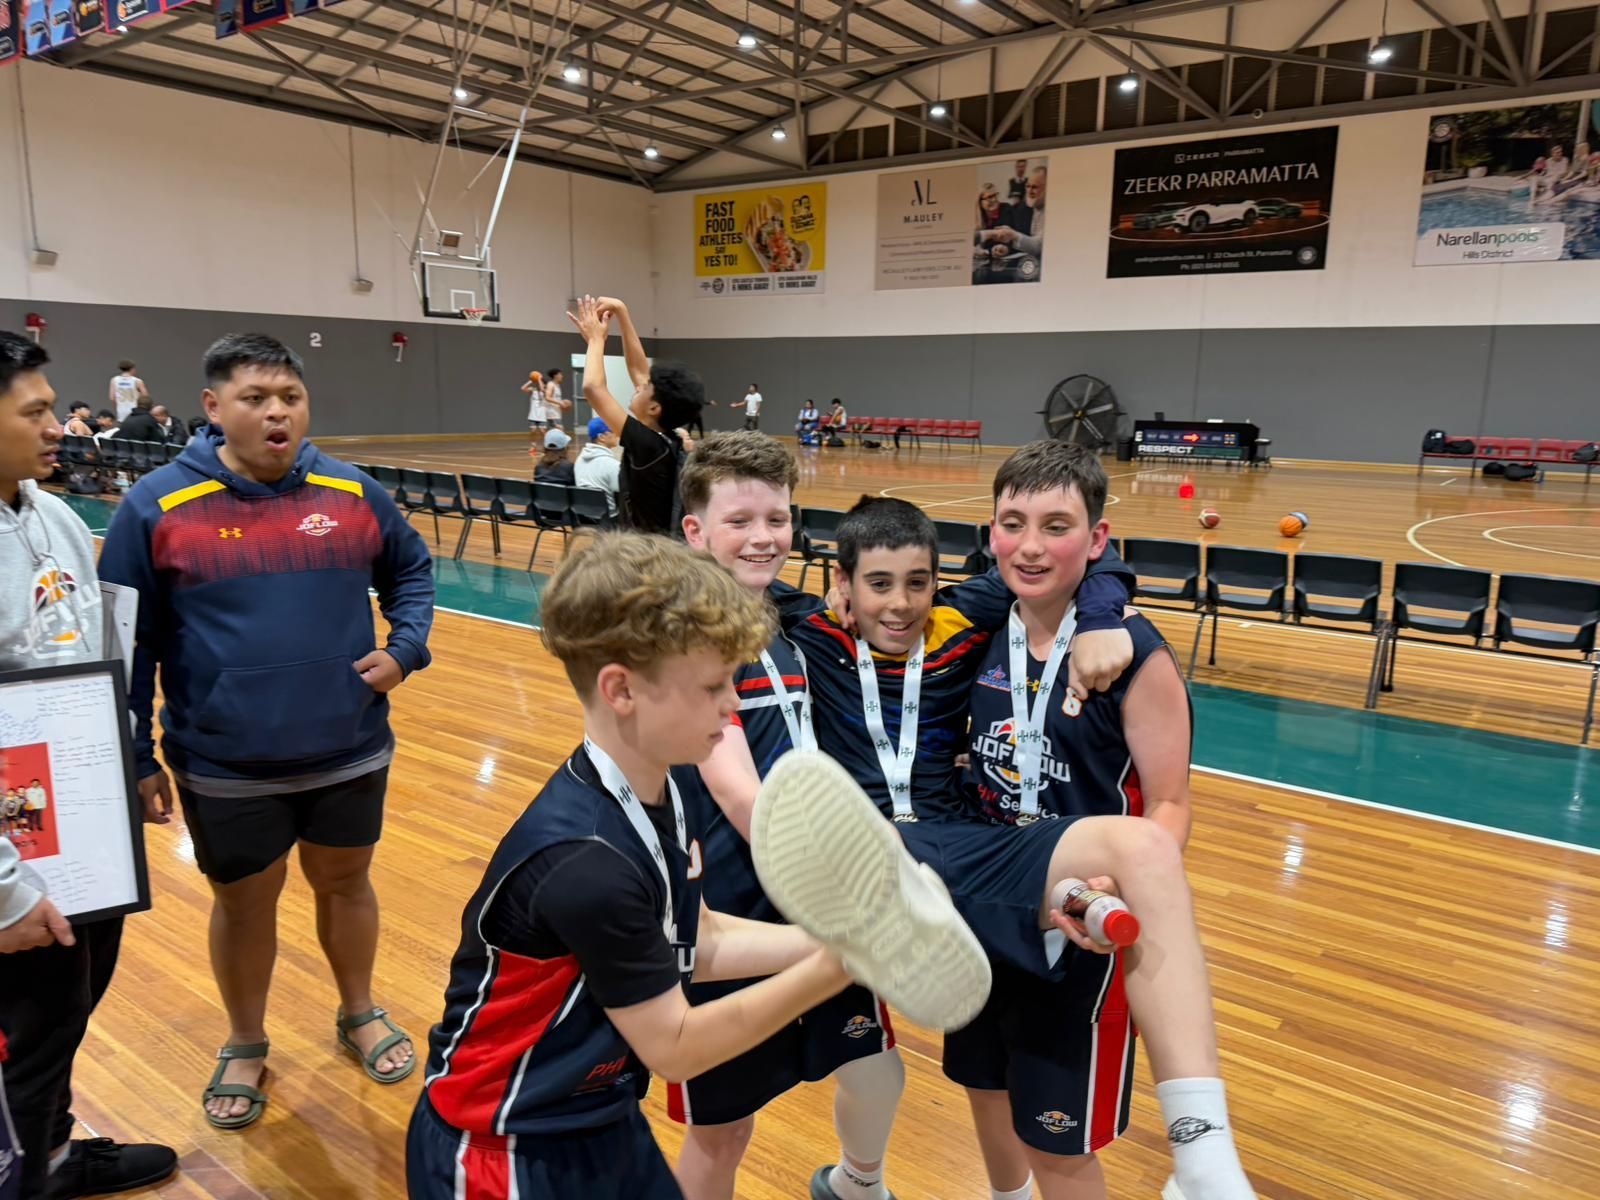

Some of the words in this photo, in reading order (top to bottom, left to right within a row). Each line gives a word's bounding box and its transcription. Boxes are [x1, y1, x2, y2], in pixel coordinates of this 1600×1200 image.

[1124, 174, 1182, 195] ZEEKR
[1186, 162, 1320, 190] PARRAMATTA
[705, 201, 735, 218] FAST
[706, 217, 735, 234] FOOD
[700, 232, 743, 247] ATHLETES
[704, 256, 721, 267] YES
[724, 254, 738, 266] TO!
[1462, 251, 1481, 259] Hills
[1481, 250, 1514, 259] District
[310, 333, 322, 347] 2
[1138, 445, 1194, 454] RESPECT
[1035, 1115, 1078, 1127] JOFLOW
